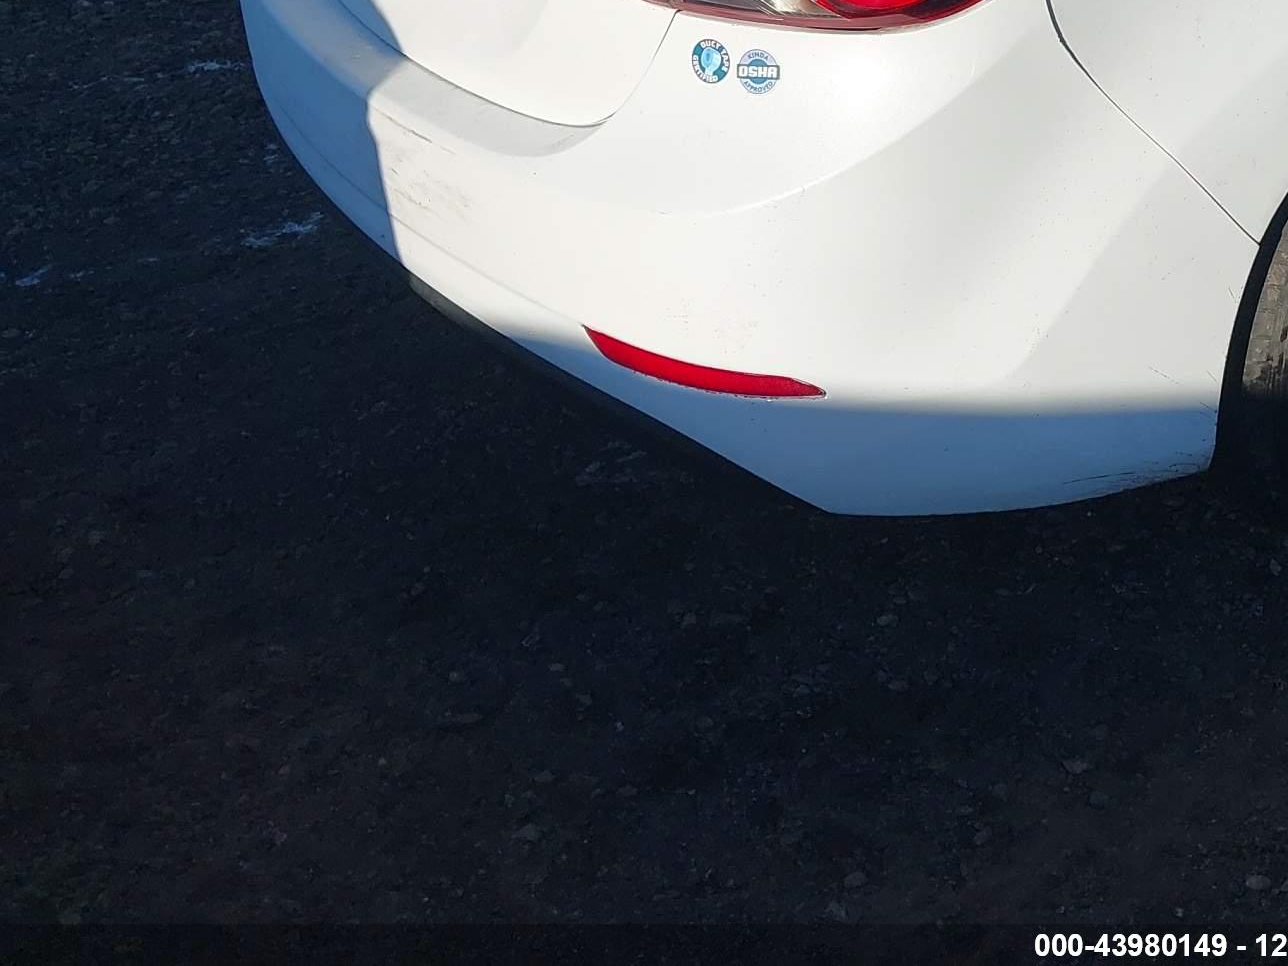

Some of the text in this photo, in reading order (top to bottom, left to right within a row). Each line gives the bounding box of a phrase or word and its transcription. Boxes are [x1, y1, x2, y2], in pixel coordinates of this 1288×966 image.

[748, 51, 769, 61] KINDA
[739, 65, 778, 78] OSHA
[744, 80, 773, 93] APPROVED
